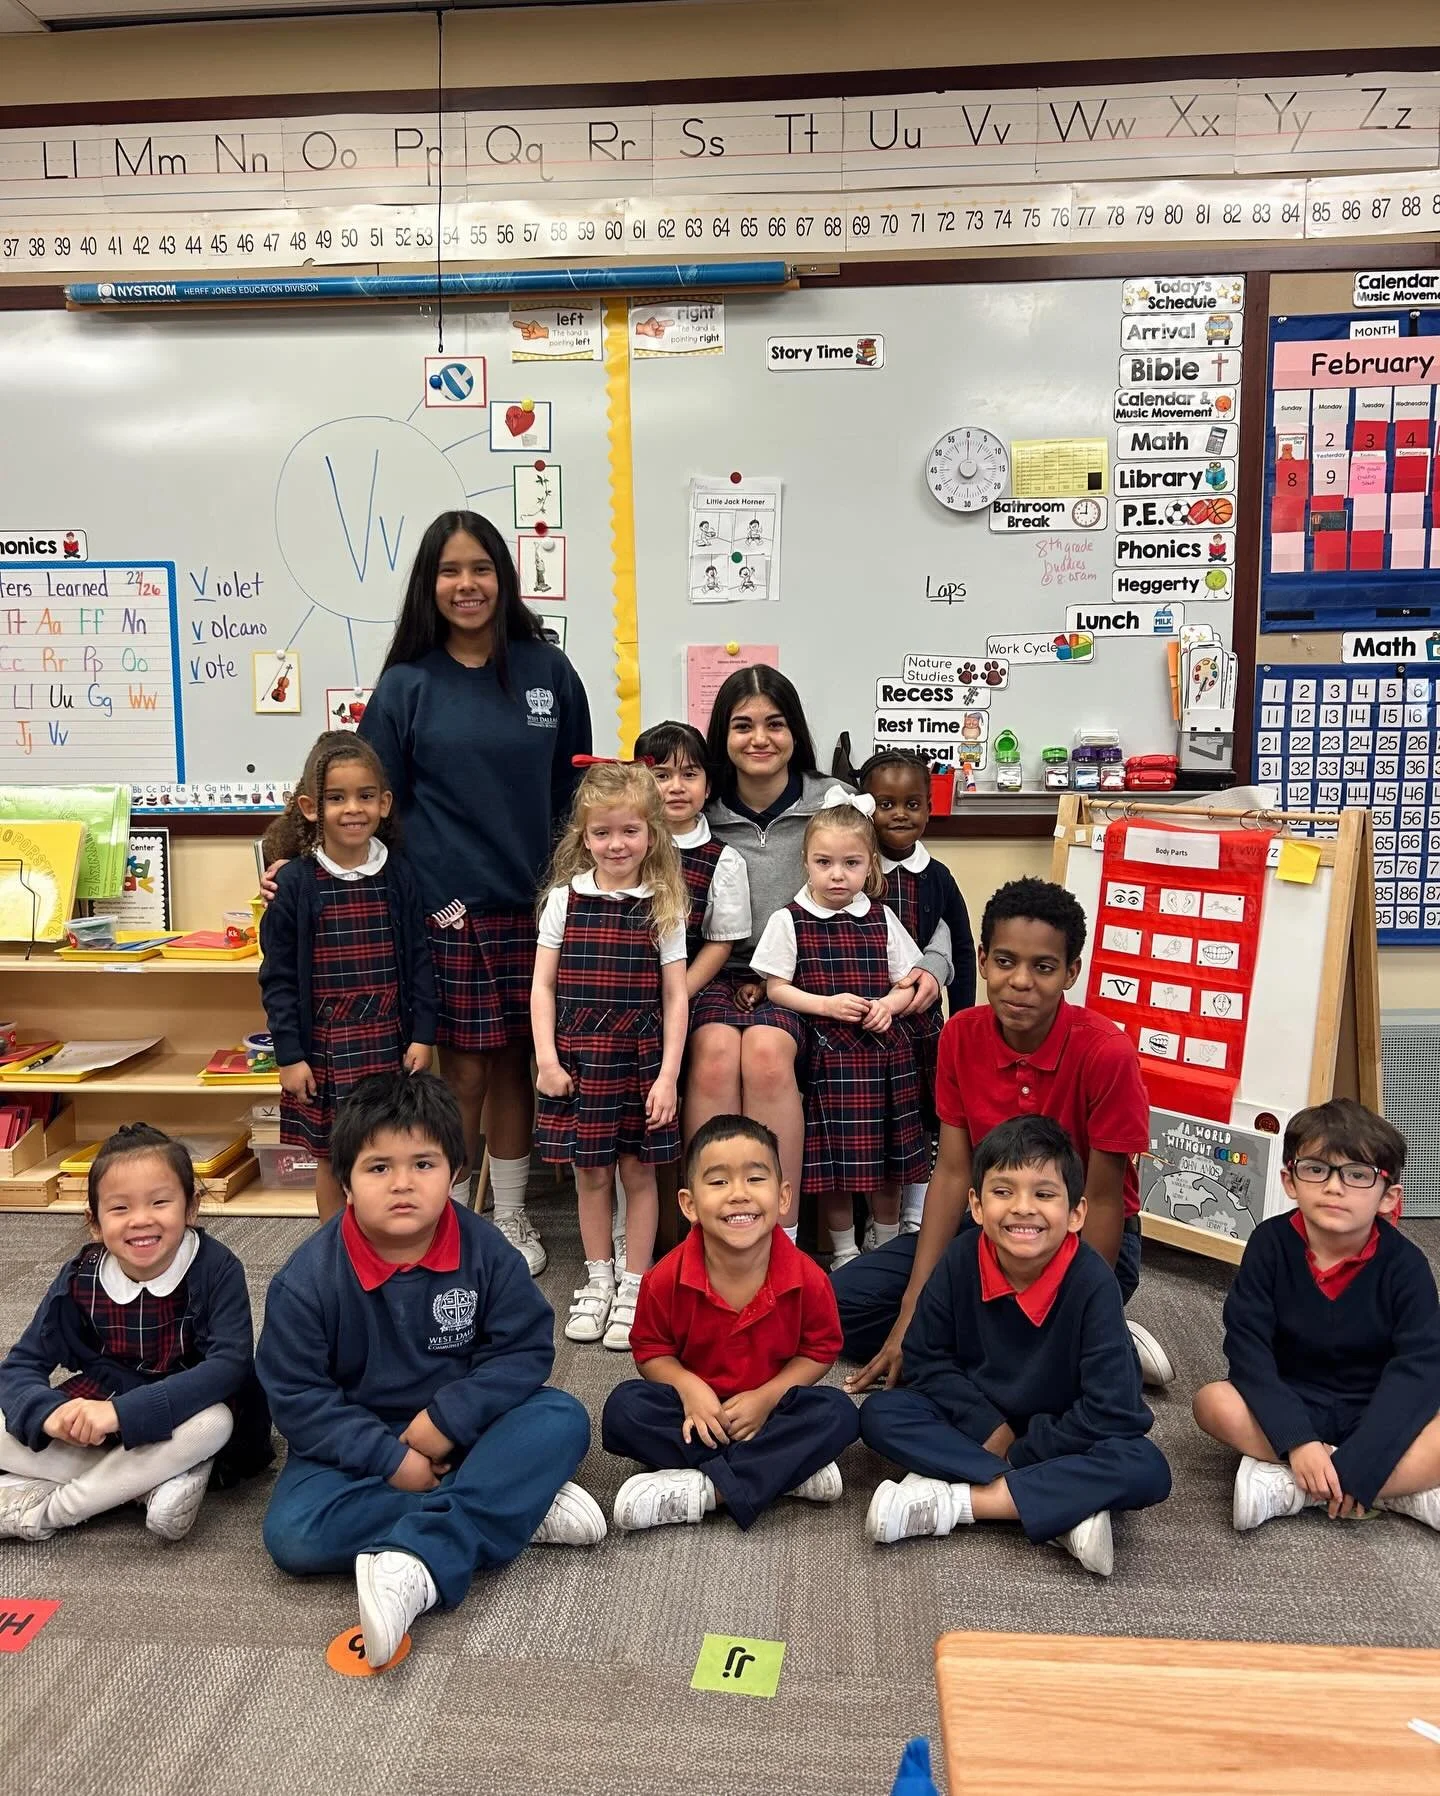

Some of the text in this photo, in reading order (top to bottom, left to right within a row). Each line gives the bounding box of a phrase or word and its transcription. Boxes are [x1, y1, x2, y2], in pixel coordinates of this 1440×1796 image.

[1166, 95, 1220, 137] Xx
[1360, 88, 1411, 129] Zz
[962, 105, 1011, 145] Vv
[1049, 99, 1136, 142] Ww
[1264, 92, 1312, 153] Yy
[680, 118, 725, 157] Ss
[775, 113, 818, 154] Tt
[870, 109, 921, 150] Uu
[589, 121, 636, 161] Rr
[115, 137, 187, 175] Mm
[215, 134, 268, 173] Nn
[302, 131, 357, 170] Oo
[394, 128, 443, 186] Pp
[486, 125, 554, 182] Qq
[43, 140, 77, 179] Ll
[3, 196, 1420, 257] 37 40 46 50 56 60 62 64 66 70 73 80 82 86 88
[1155, 281, 1212, 295] Today's
[1359, 274, 1439, 289] Calendar
[118, 285, 176, 297] NYSTROM
[211, 287, 237, 295] JONES
[239, 285, 283, 294] EDUCATION
[285, 284, 319, 292] DIVISION
[1357, 291, 1390, 301] Music
[1148, 296, 1217, 309] Schedule
[557, 313, 584, 326] left
[678, 305, 715, 322] right
[671, 334, 719, 344] pointing right
[1127, 323, 1195, 340] Arrival
[1355, 326, 1396, 337] MONTH
[575, 338, 591, 346] left
[771, 344, 853, 362] Story Time
[1131, 357, 1200, 382] Bible
[1312, 352, 1435, 379] February
[1118, 392, 1196, 406] Calendar
[1116, 407, 1213, 418] Music Movement
[1131, 432, 1189, 451] Math
[1326, 433, 1335, 447] 2
[1365, 434, 1375, 448] 3
[1405, 432, 1416, 447] 4
[1120, 470, 1203, 490] Library
[1288, 473, 1297, 487] 8
[1326, 470, 1336, 484] 9
[993, 500, 1065, 513] Bathroom
[1123, 503, 1164, 526] P.E.
[325, 449, 405, 582] Vv
[1007, 515, 1050, 528] Break
[1035, 537, 1094, 560] 8th grade
[1118, 540, 1201, 559] Phonics
[47, 570, 108, 597] Learned
[190, 566, 264, 602] Violet
[926, 575, 967, 605] Laps
[1118, 577, 1200, 594] Heggerty
[35, 608, 62, 634] Aa
[80, 608, 104, 635] Ff
[122, 607, 147, 634] Nn
[1077, 611, 1140, 630] Lunch
[1155, 617, 1172, 626] MILK
[988, 642, 1057, 655] Work Cycle
[1353, 637, 1416, 657] Math
[43, 647, 68, 672] Rr
[83, 646, 104, 682] Pp
[122, 648, 148, 672] Oo
[908, 657, 952, 669] Nature
[907, 670, 954, 683] Studies
[882, 685, 954, 702] Recess
[1300, 684, 1397, 698] 2 5
[50, 685, 74, 709] Uu
[88, 683, 113, 717] Gg
[129, 683, 158, 710] Ww
[1325, 710, 1339, 723] 13
[878, 718, 961, 733] Rest Time
[16, 721, 69, 755] Jj Vv
[1261, 737, 1277, 751] 21
[1344, 761, 1364, 775] 34
[161, 785, 171, 793] Dd
[1376, 787, 1397, 801] 45
[1402, 811, 1422, 825] 56
[1155, 847, 1188, 857] Body Parts
[1400, 887, 1419, 900] 86
[1399, 911, 1418, 924] 96
[1195, 1126, 1231, 1145] WORLD
[1167, 1136, 1249, 1166] WITHOUT COLOR
[1181, 1158, 1221, 1178] JOHN AMOS
[429, 1334, 452, 1344] WEST
